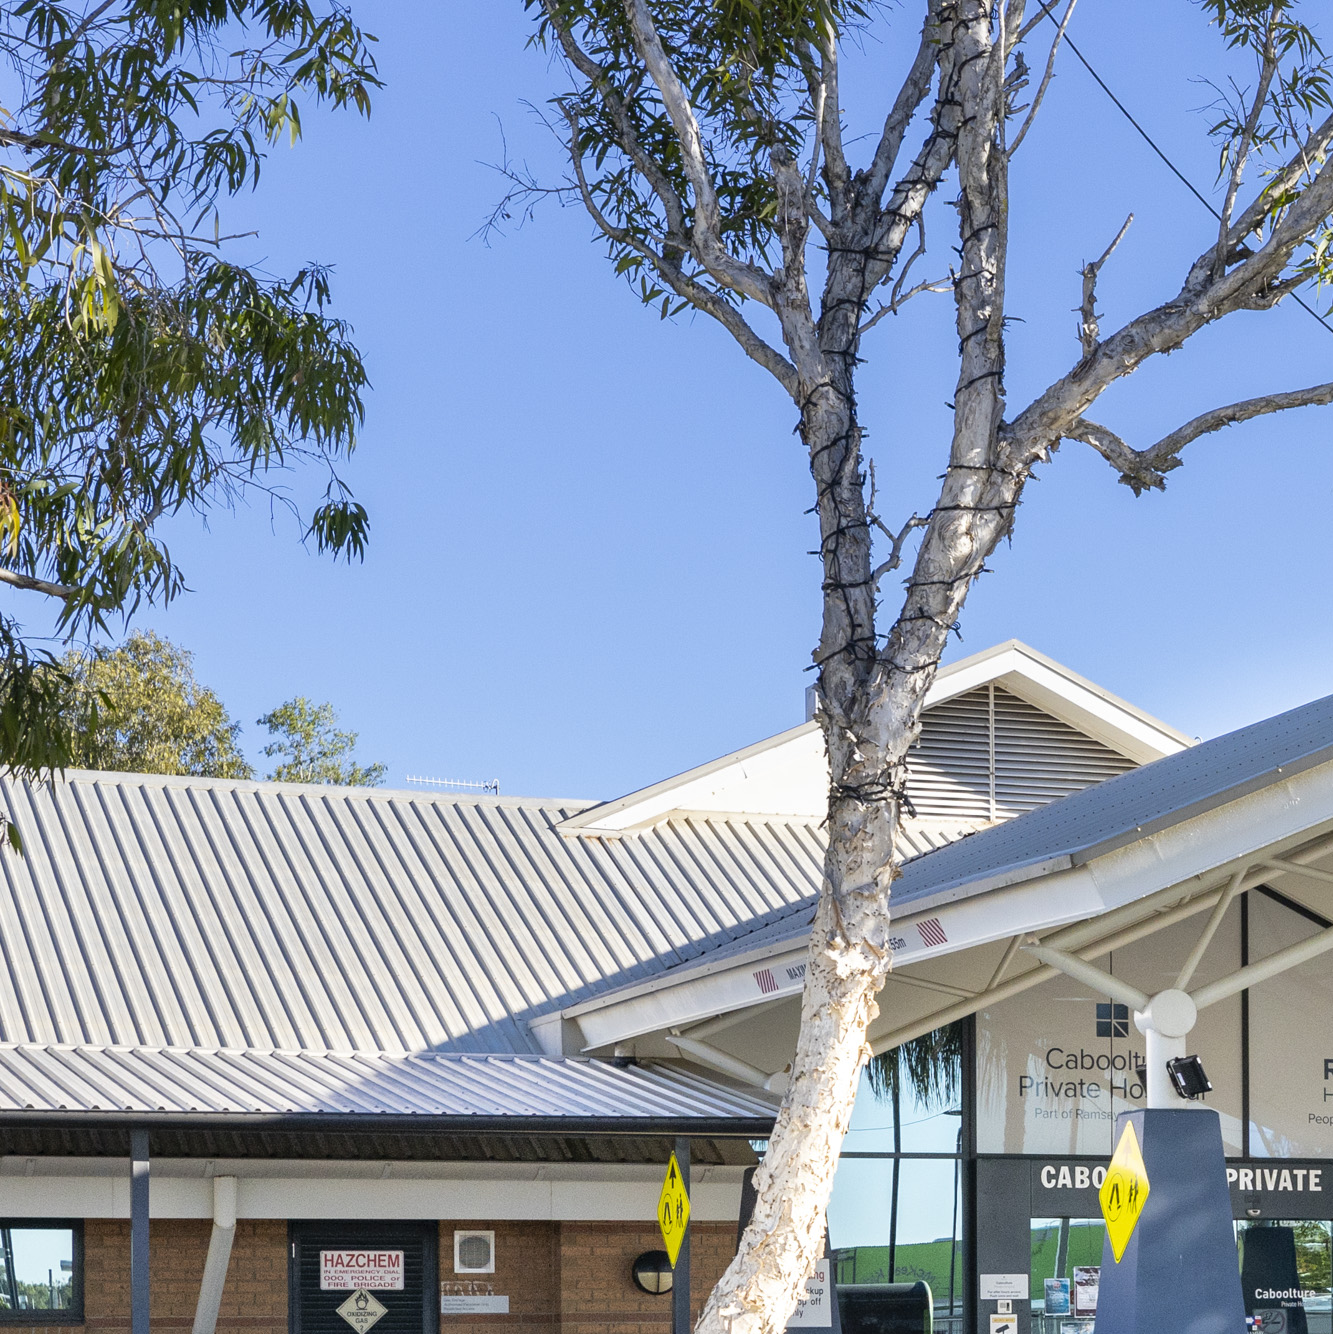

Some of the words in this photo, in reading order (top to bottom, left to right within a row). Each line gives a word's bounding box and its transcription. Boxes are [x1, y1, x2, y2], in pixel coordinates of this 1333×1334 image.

[1019, 1075, 1100, 1099] Private
[1034, 1108, 1060, 1119] Part
[1061, 1107, 1073, 1119] of
[1227, 1168, 1322, 1192] PRIVATE
[324, 1253, 400, 1268] HAZCHEM
[1255, 1288, 1317, 1299] Caboolture
